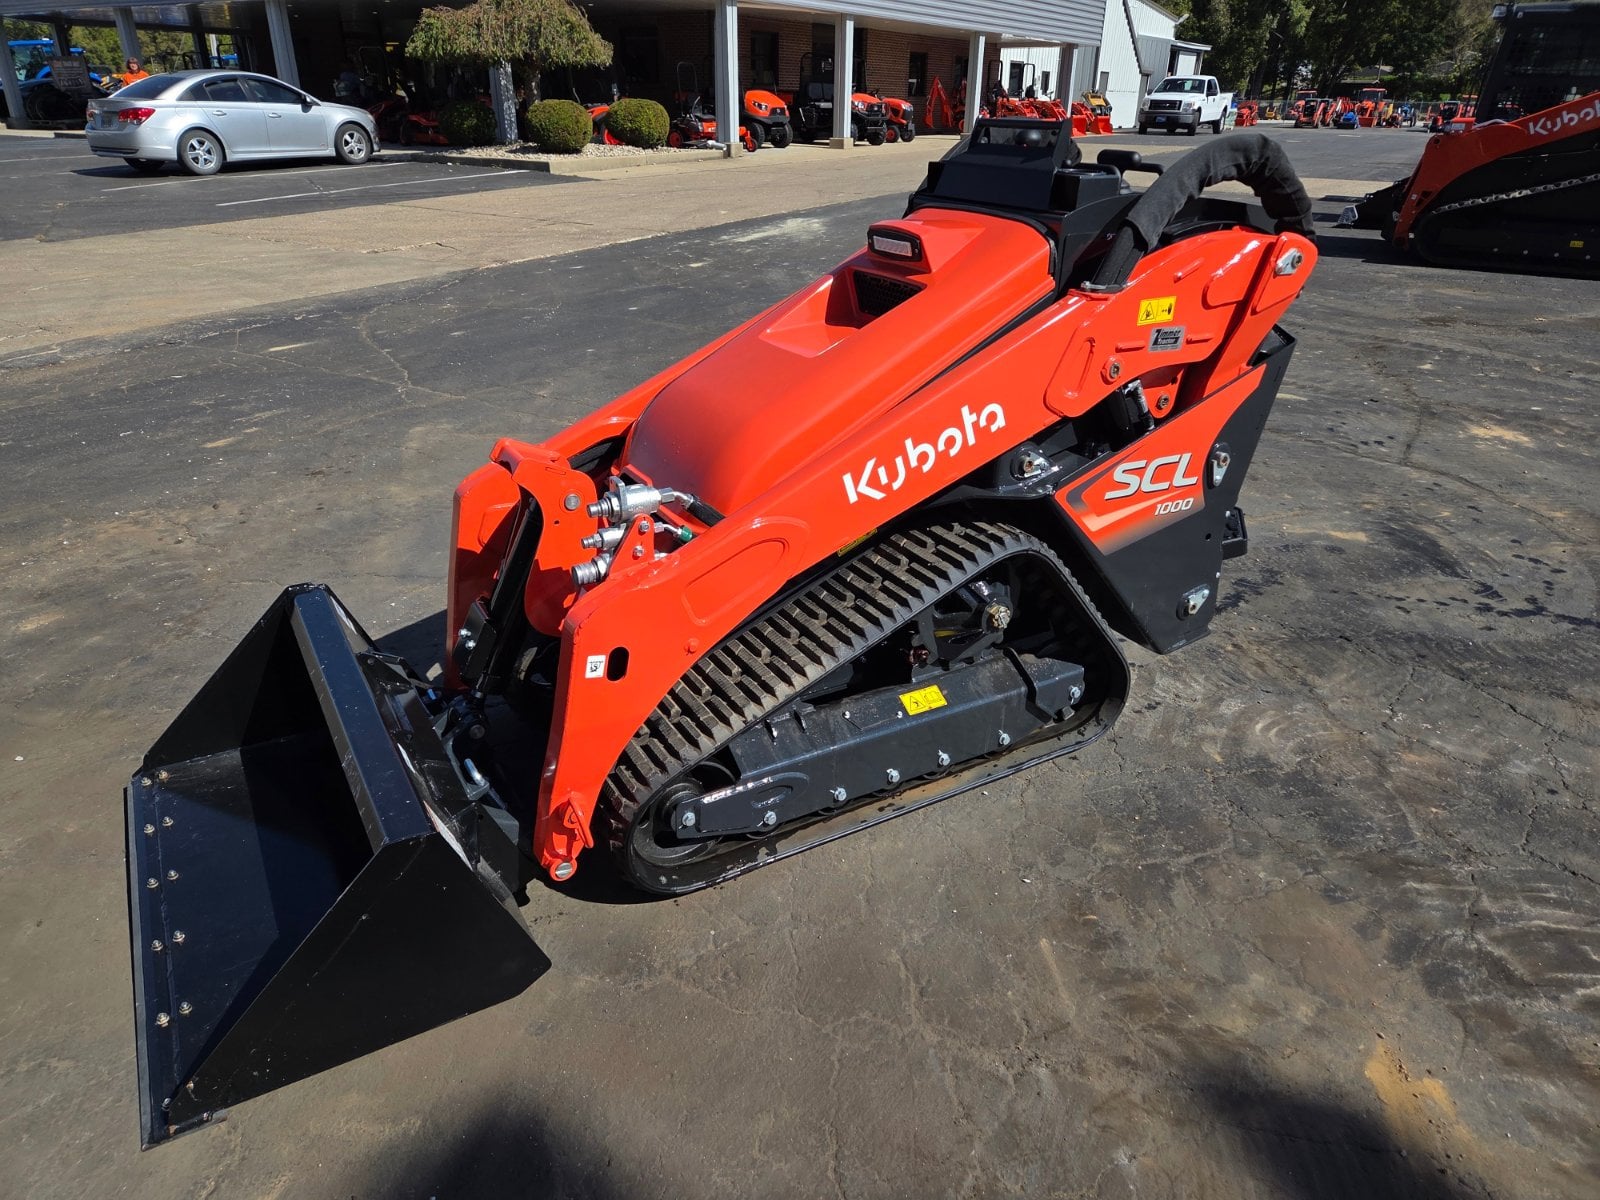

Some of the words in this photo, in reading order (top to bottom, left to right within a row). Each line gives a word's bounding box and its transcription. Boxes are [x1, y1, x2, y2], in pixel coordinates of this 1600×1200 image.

[1528, 99, 1600, 135] Kubot
[1152, 328, 1182, 343] Zimmer
[842, 403, 1006, 504] Kubota
[1104, 452, 1198, 500] SCL
[1154, 497, 1194, 516] 1000
